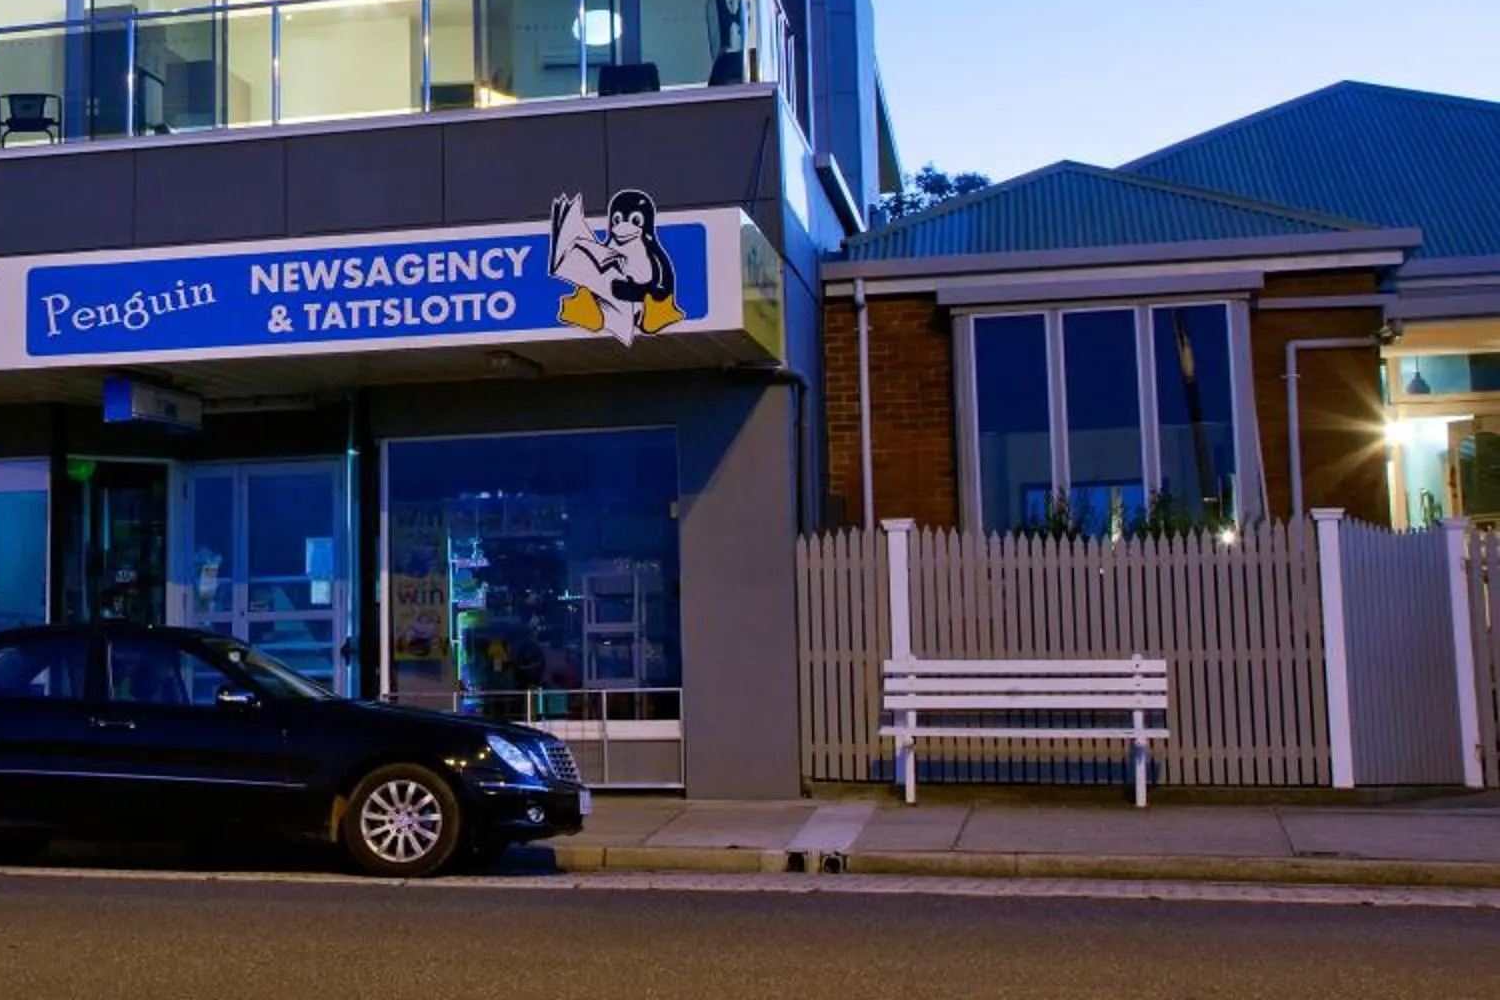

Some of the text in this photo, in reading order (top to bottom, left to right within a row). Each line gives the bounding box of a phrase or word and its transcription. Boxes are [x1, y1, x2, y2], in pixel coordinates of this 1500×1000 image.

[250, 245, 533, 295] NEWSAGENCY
[41, 280, 217, 337] Penguin
[267, 291, 517, 334] & TATTSLOTTO
